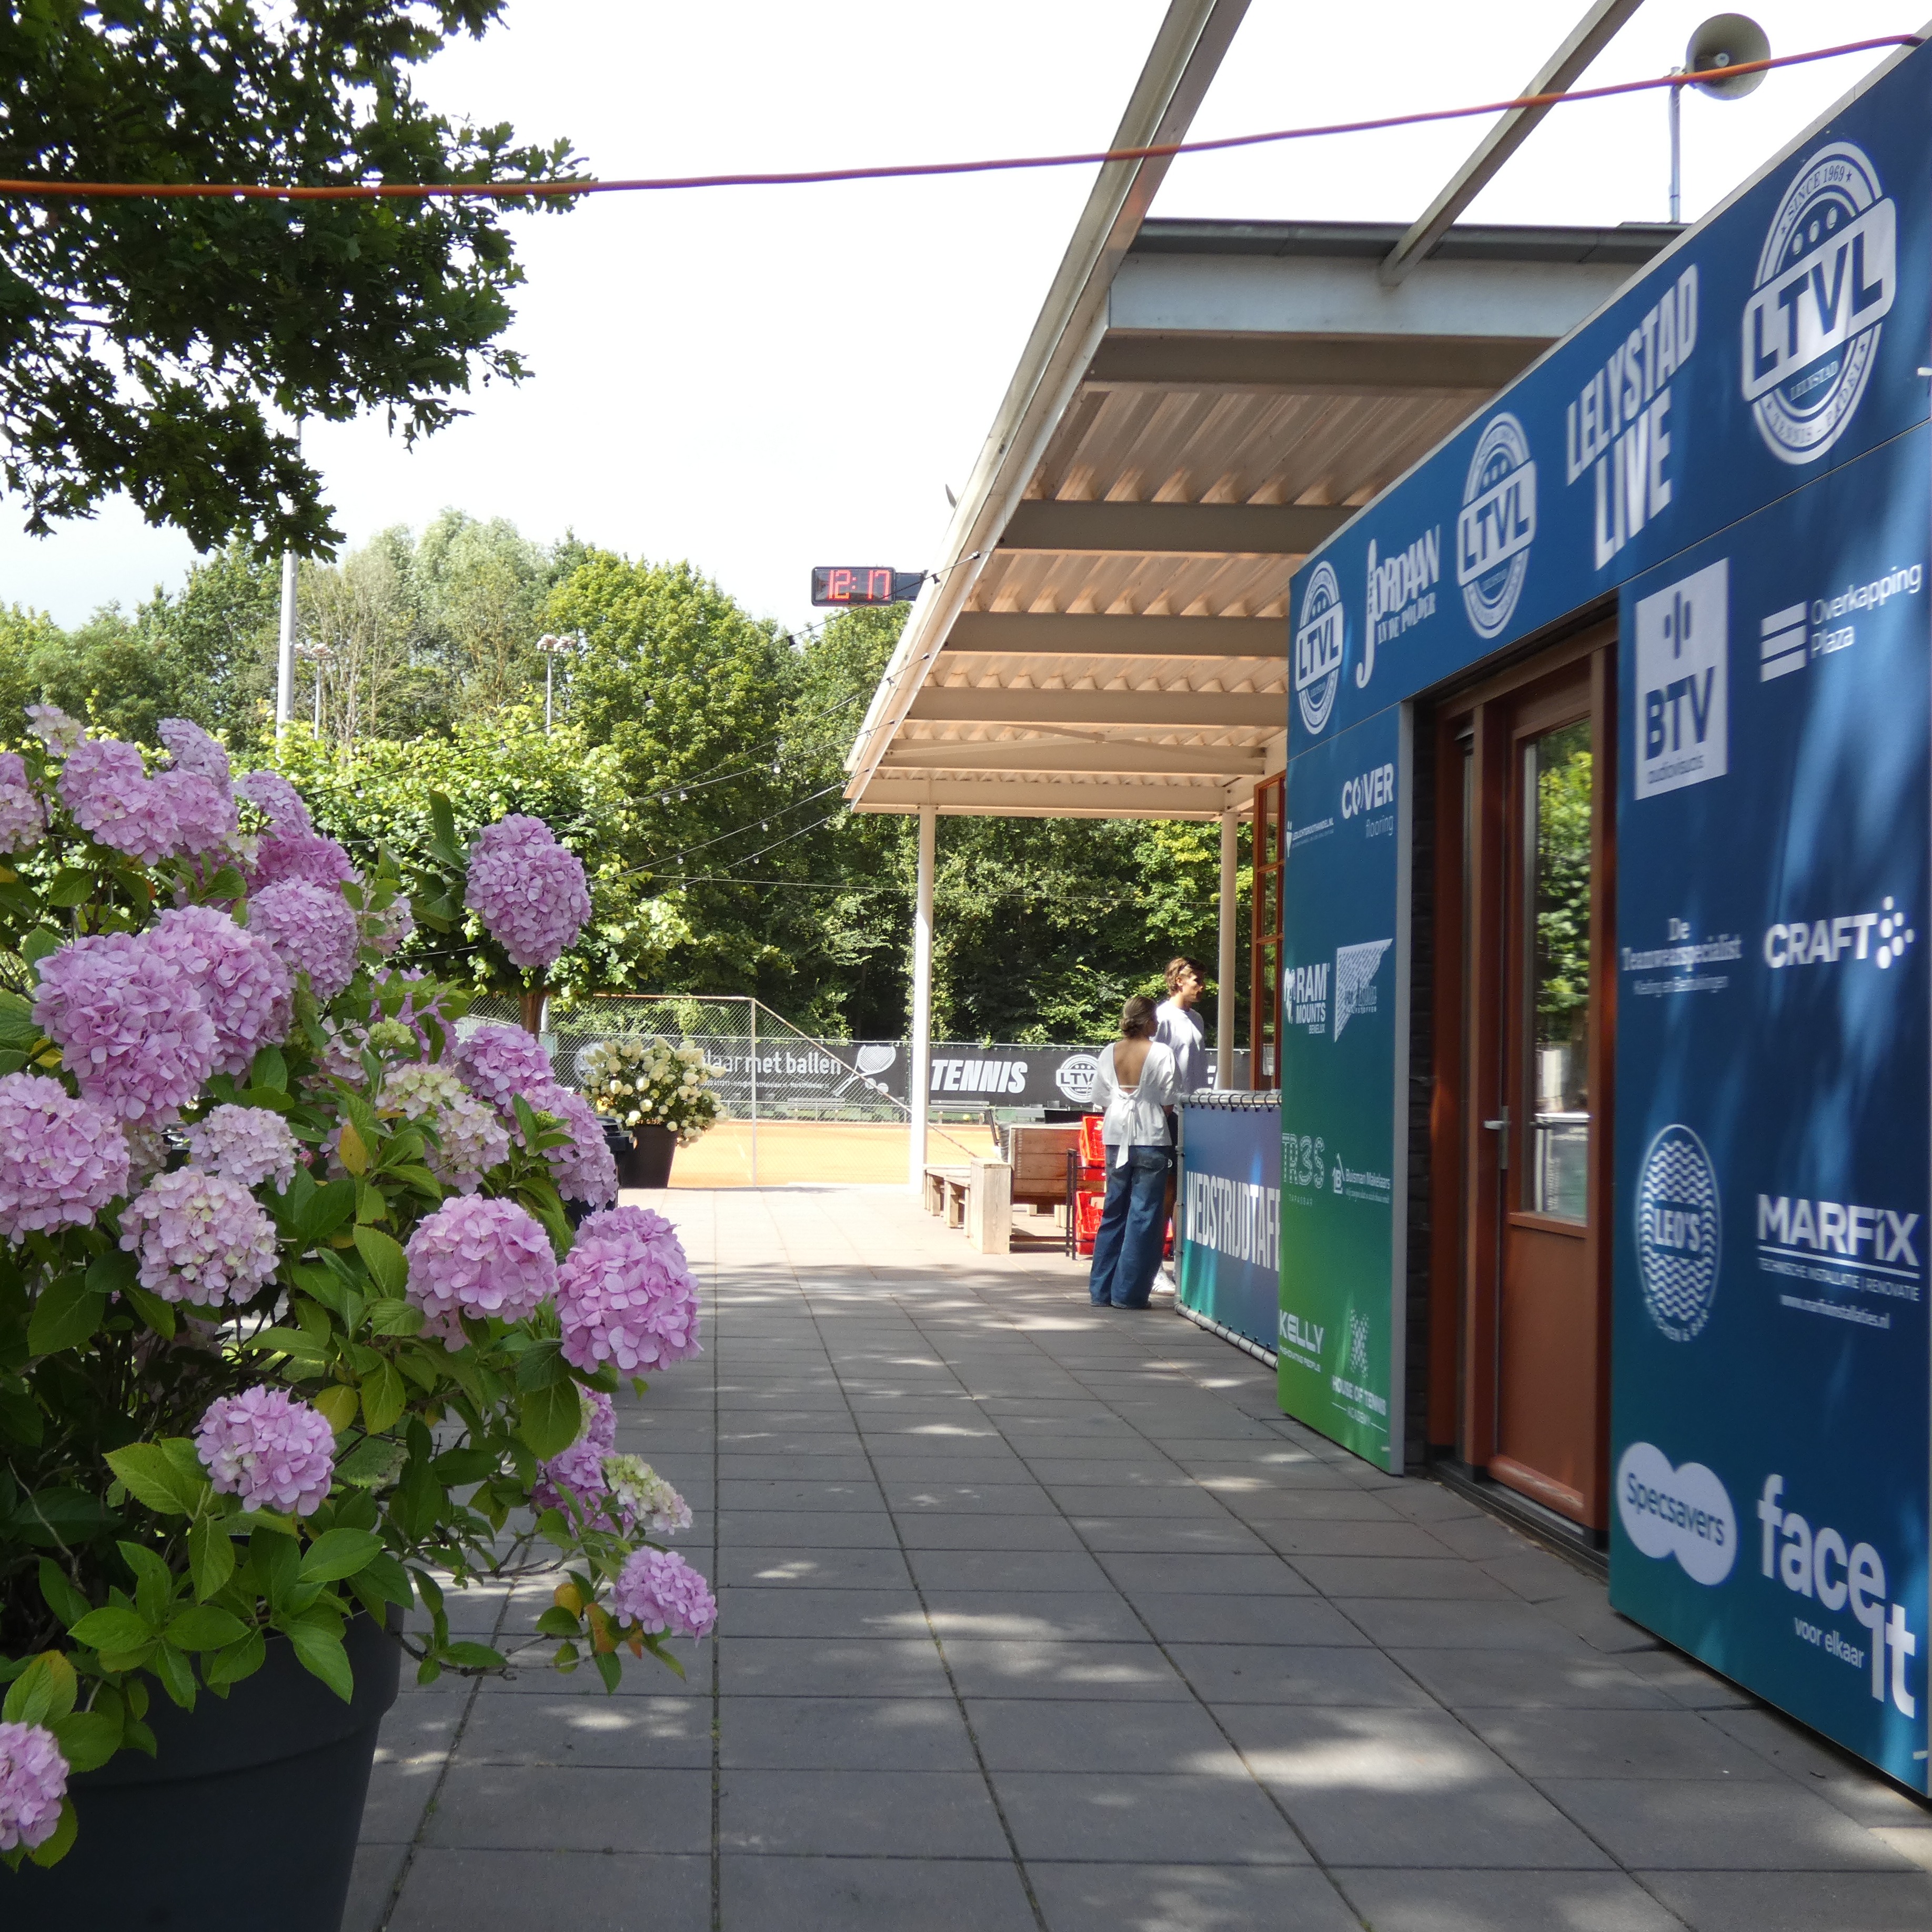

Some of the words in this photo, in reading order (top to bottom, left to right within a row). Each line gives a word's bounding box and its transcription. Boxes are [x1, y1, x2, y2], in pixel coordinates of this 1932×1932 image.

[1788, 171, 1820, 221] SINCE
[1823, 165, 1845, 184] 1969
[1754, 230, 1883, 370] LTVL
[1567, 264, 1698, 486] LELYSTAD
[1595, 387, 1671, 571] LIVE
[1463, 480, 1529, 571] LTVL
[828, 570, 890, 599] 12:17
[1356, 524, 1440, 688] JORDAAN
[1812, 564, 1922, 625] Overkapping
[1298, 615, 1339, 681] LTVL
[1812, 626, 1855, 659] Plaza
[1645, 666, 1716, 761] BTV
[1342, 763, 1393, 819] COVER
[1668, 917, 1689, 941] De
[1764, 912, 1877, 969] CRAFT
[1297, 963, 1327, 1003] RAM
[1296, 1002, 1325, 1024] MOUNTS
[745, 1052, 782, 1073] met
[786, 1052, 842, 1075] ballen
[930, 1059, 1028, 1094] TENNIS
[1757, 1194, 1919, 1266] MARFIX
[1865, 1277, 1920, 1302] RENOVATIE
[1280, 1309, 1324, 1354] KELLY
[1627, 1472, 1725, 1547] Specsavers
[1795, 1617, 1822, 1646] voor
[1825, 1630, 1865, 1669] elkaar
